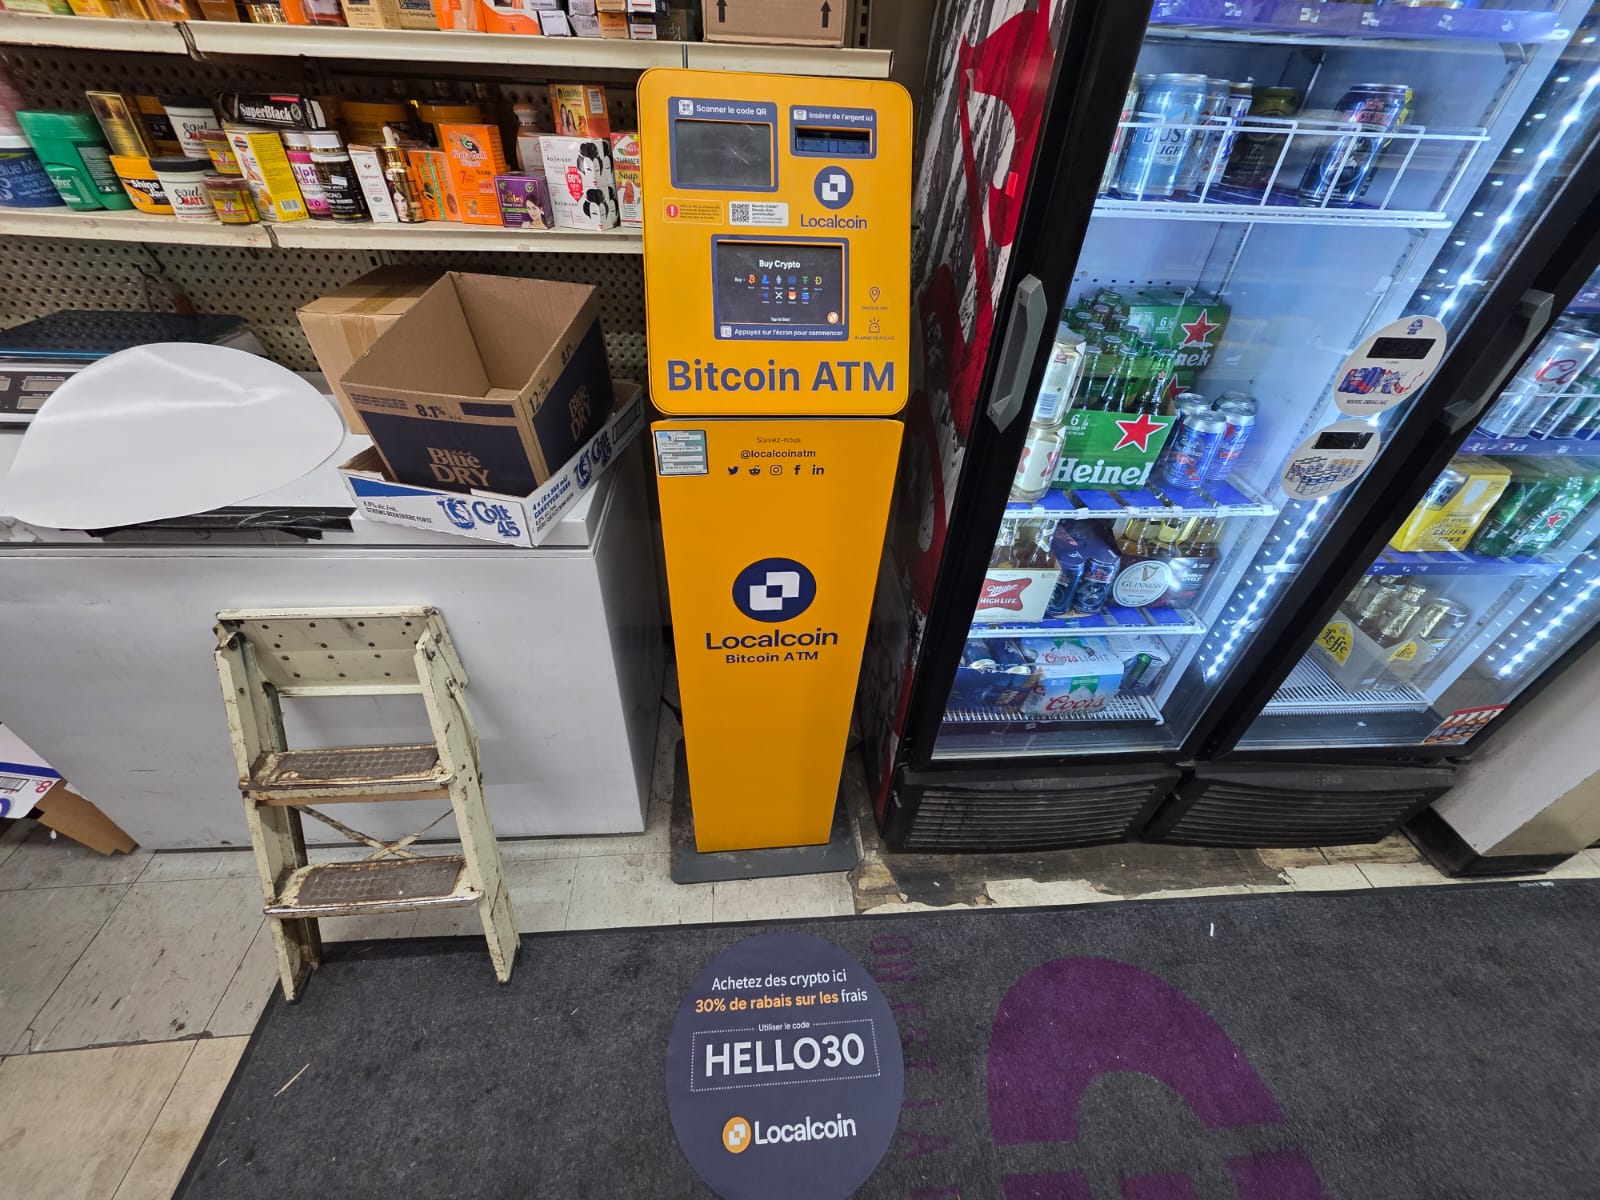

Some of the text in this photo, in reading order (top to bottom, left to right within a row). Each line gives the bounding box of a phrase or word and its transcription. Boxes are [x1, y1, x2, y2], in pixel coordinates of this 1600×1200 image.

[239, 103, 292, 121] SuperBlack
[696, 104, 726, 115] Scanner
[736, 106, 755, 115] code
[756, 107, 767, 116] QR
[865, 114, 873, 122] ici
[618, 171, 638, 182] Soap
[182, 196, 206, 206] MATE
[800, 214, 867, 229] Localcoin
[759, 260, 801, 270] Buy Crypto
[734, 328, 761, 338] Appuyez
[667, 358, 895, 392] Bitcoin ATM
[1071, 414, 1079, 426] 6
[427, 447, 482, 469] Blue
[741, 450, 816, 459] @localcoinatm
[430, 463, 489, 487] DRY
[472, 501, 513, 525] Colt
[498, 521, 521, 538] 45
[987, 584, 1018, 597] Miller
[1121, 580, 1162, 589] GUINNESS
[705, 627, 838, 650] Localcoin
[1322, 628, 1348, 654] Leffe
[726, 651, 818, 664] Bitcoin ATM
[1045, 694, 1105, 712] Coors
[711, 969, 847, 991] Achetez des crypto ici
[695, 989, 868, 1013] 30% de rabais sur les frais
[758, 1021, 810, 1031] Utiliser le code
[705, 1033, 865, 1077] HELLO30
[754, 1113, 857, 1145] Localcoin
